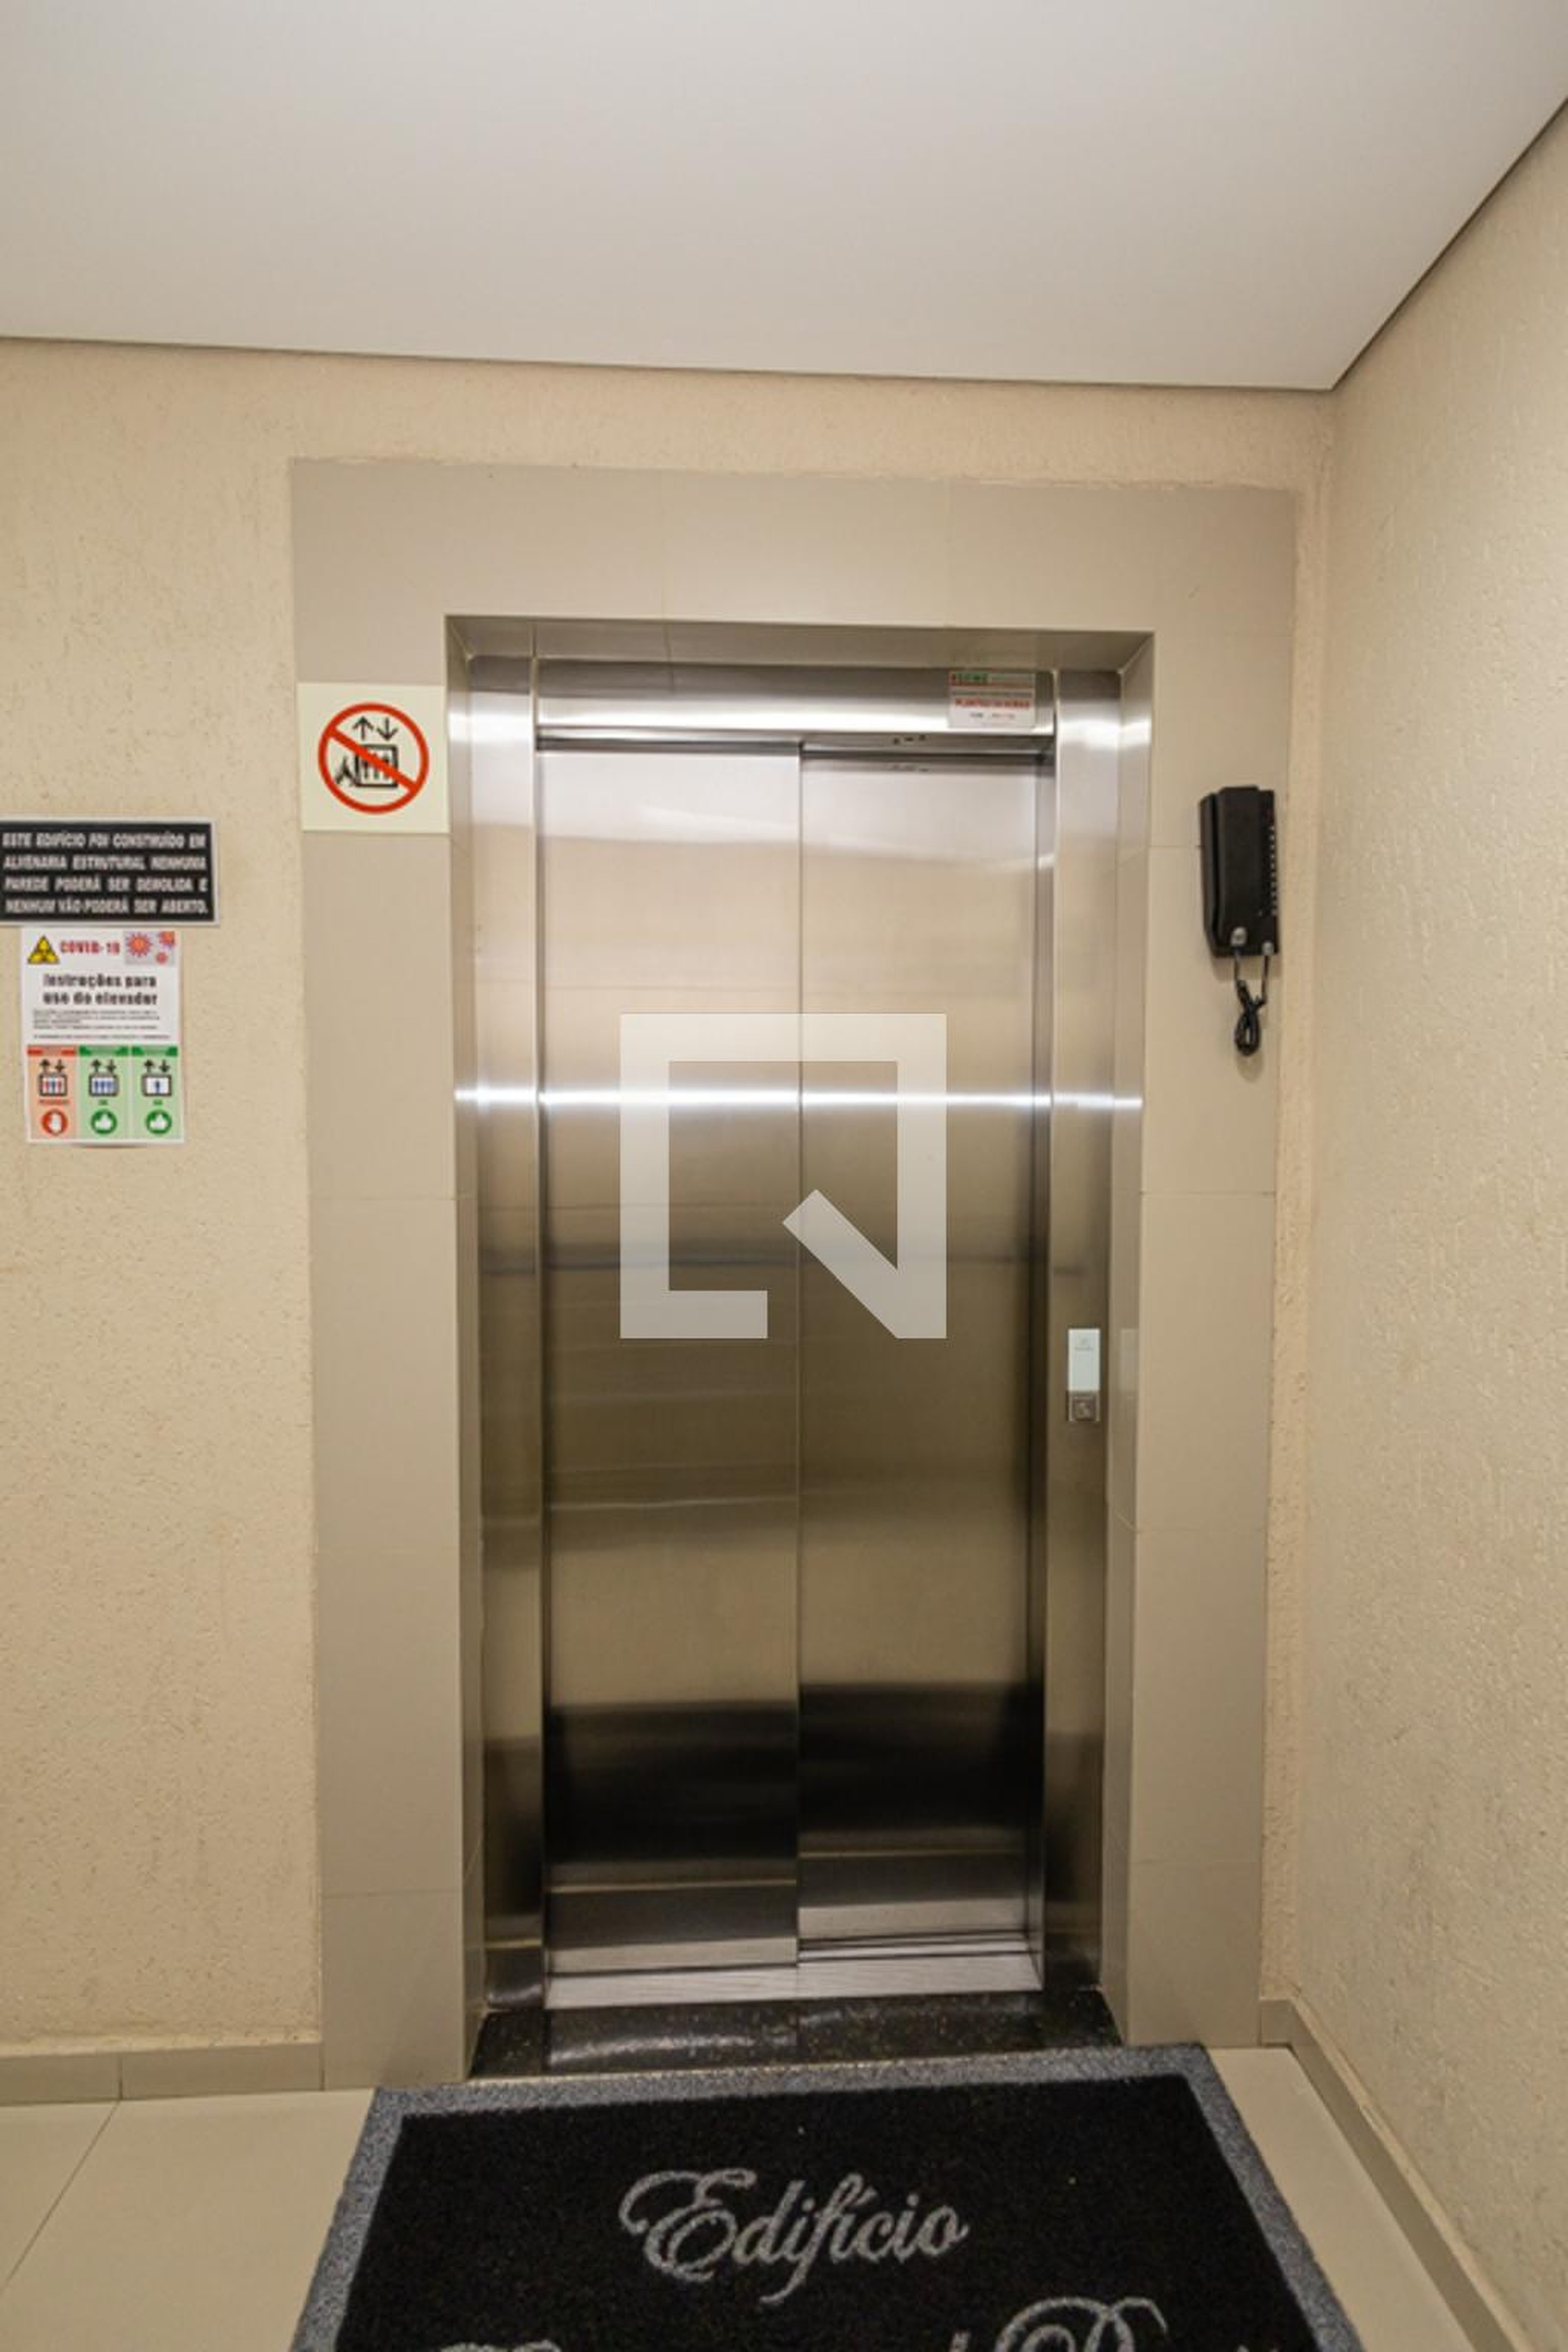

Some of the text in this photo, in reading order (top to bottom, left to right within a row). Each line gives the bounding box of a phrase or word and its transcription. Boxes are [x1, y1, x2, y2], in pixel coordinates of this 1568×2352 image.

[2, 832, 33, 849] ESTE
[36, 830, 86, 849] EDIFÍCIO
[88, 832, 109, 849] FOI
[189, 833, 207, 849] EM
[2, 855, 67, 870] ALVENARIA
[4, 874, 209, 892] PAREDE PODERÁ SER DEMOLIDA E
[5, 899, 56, 914] NENHUM
[133, 899, 158, 914] SER
[43, 973, 157, 991] Instruções para
[42, 991, 158, 1005] uso do elevador
[618, 2167, 971, 2304] Edifício
